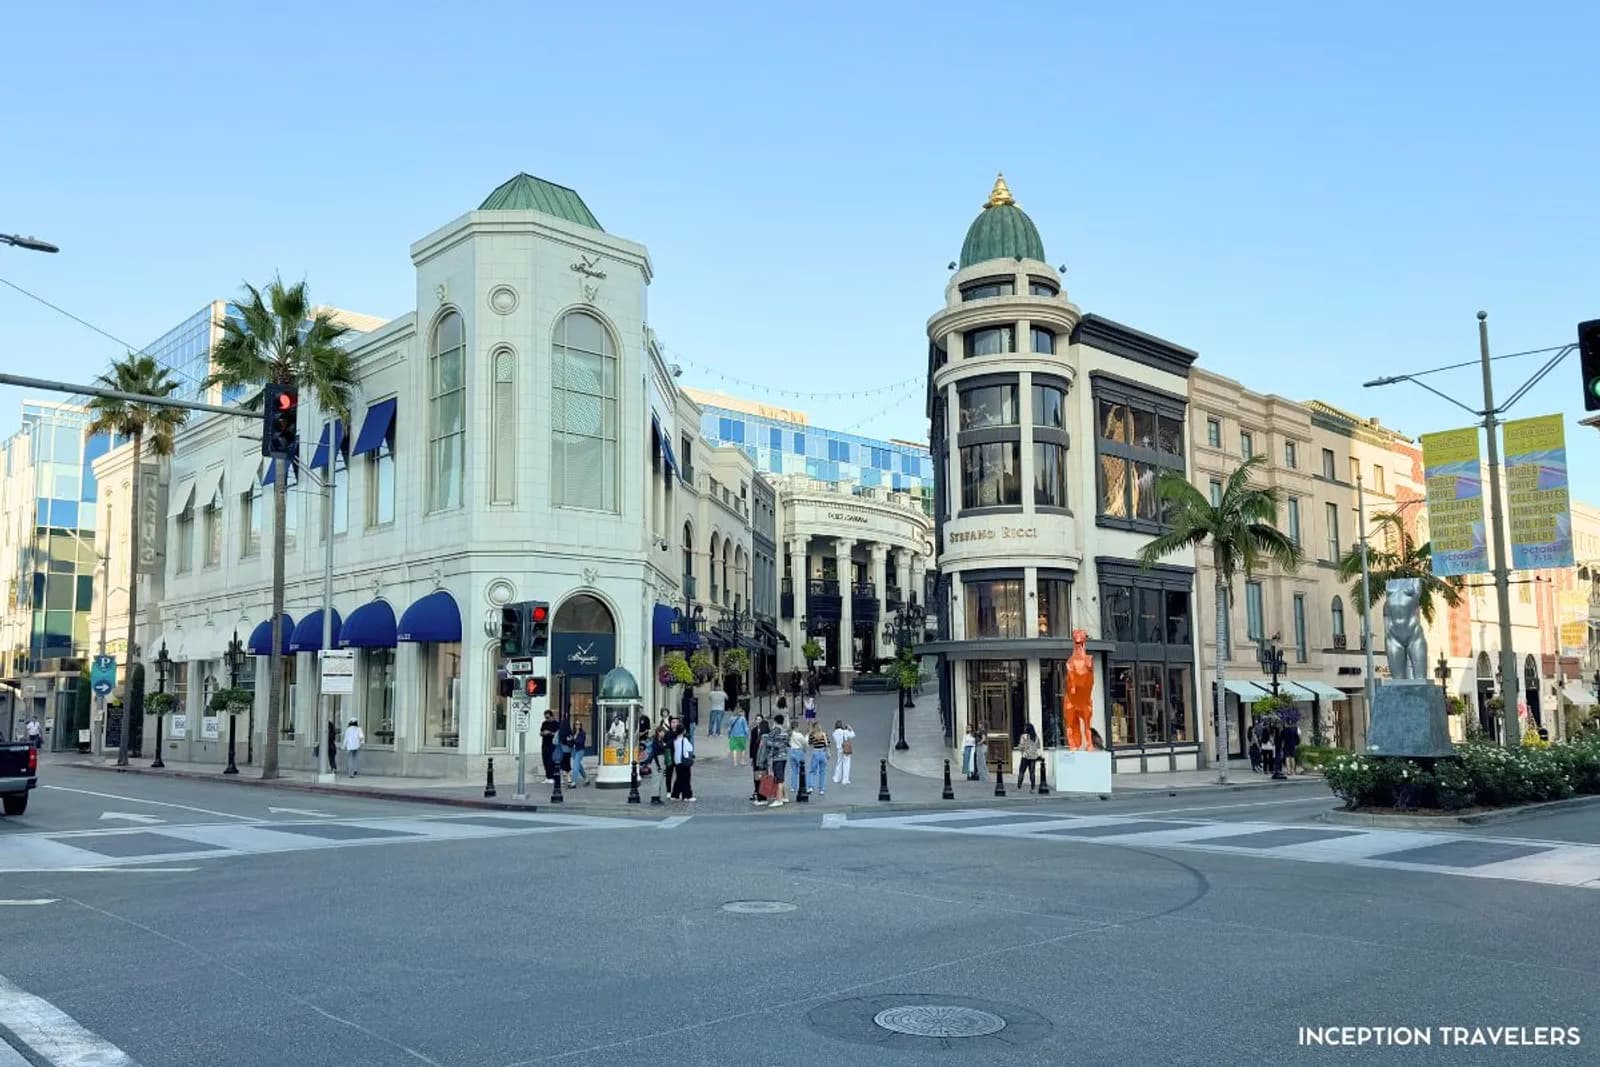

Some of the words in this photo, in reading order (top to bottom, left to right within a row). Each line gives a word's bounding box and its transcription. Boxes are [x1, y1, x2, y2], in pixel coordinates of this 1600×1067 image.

[1511, 489, 1566, 503] CELEBRATES
[1512, 503, 1566, 516] TIMEPIECES
[1513, 519, 1531, 529] AND
[1535, 518, 1555, 528] FINE
[949, 530, 996, 543] STEFANO
[1002, 526, 1038, 539] RICCI
